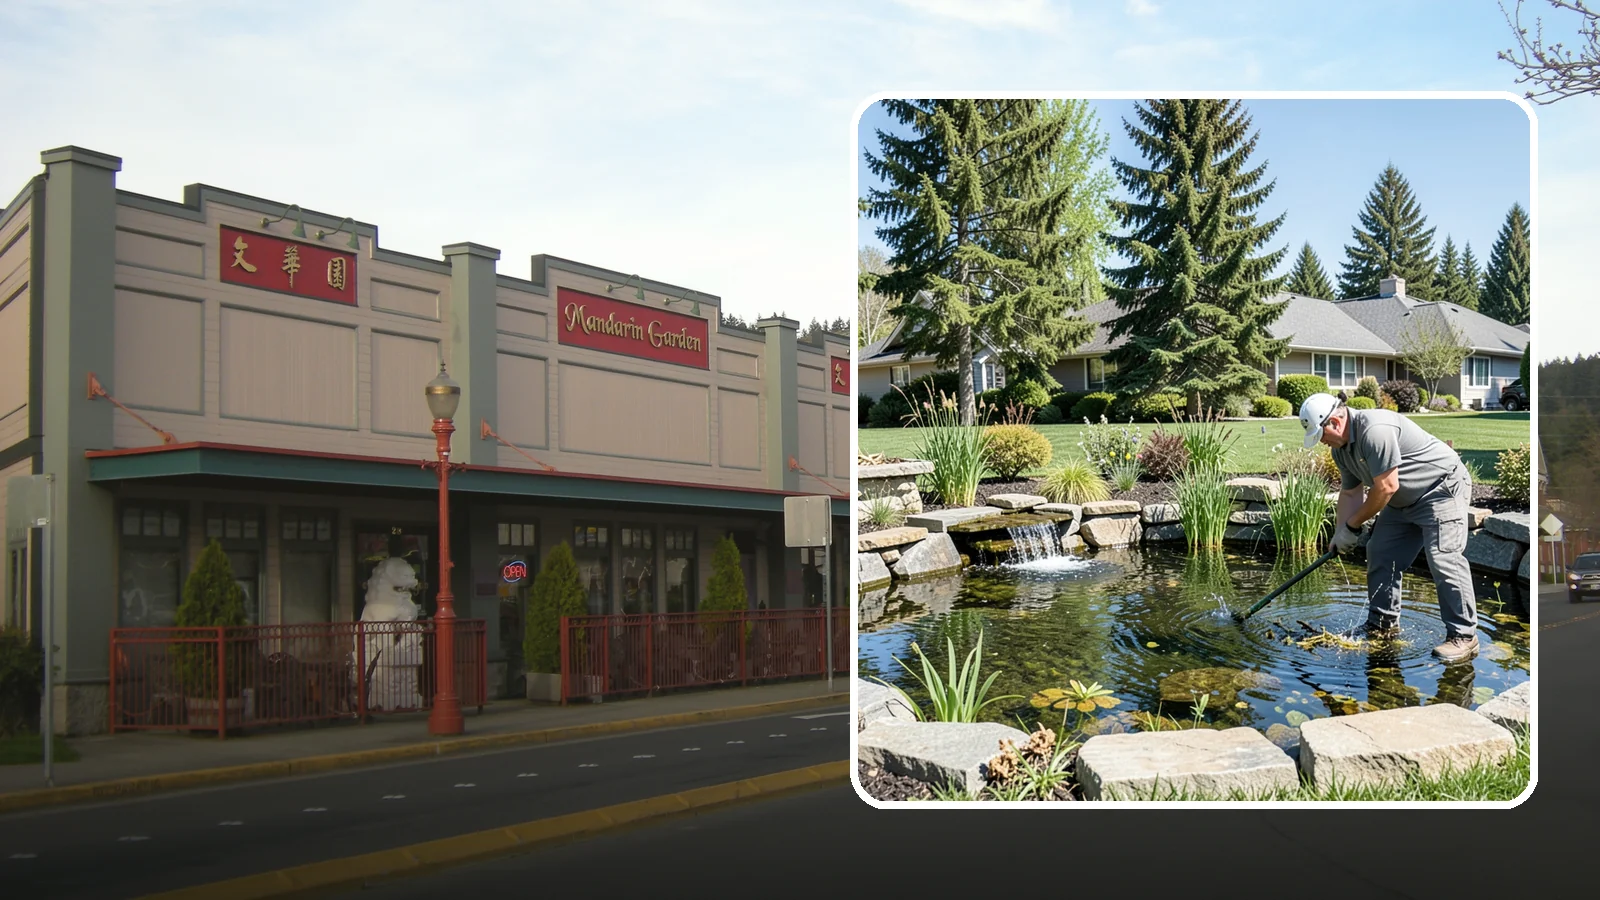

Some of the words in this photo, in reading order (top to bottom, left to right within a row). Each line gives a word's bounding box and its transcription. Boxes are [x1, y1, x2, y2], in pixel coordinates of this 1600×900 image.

[231, 235, 346, 291] 文華園
[564, 301, 644, 341] Mandarin
[647, 319, 702, 352] Garden
[503, 564, 527, 578] OPEN
